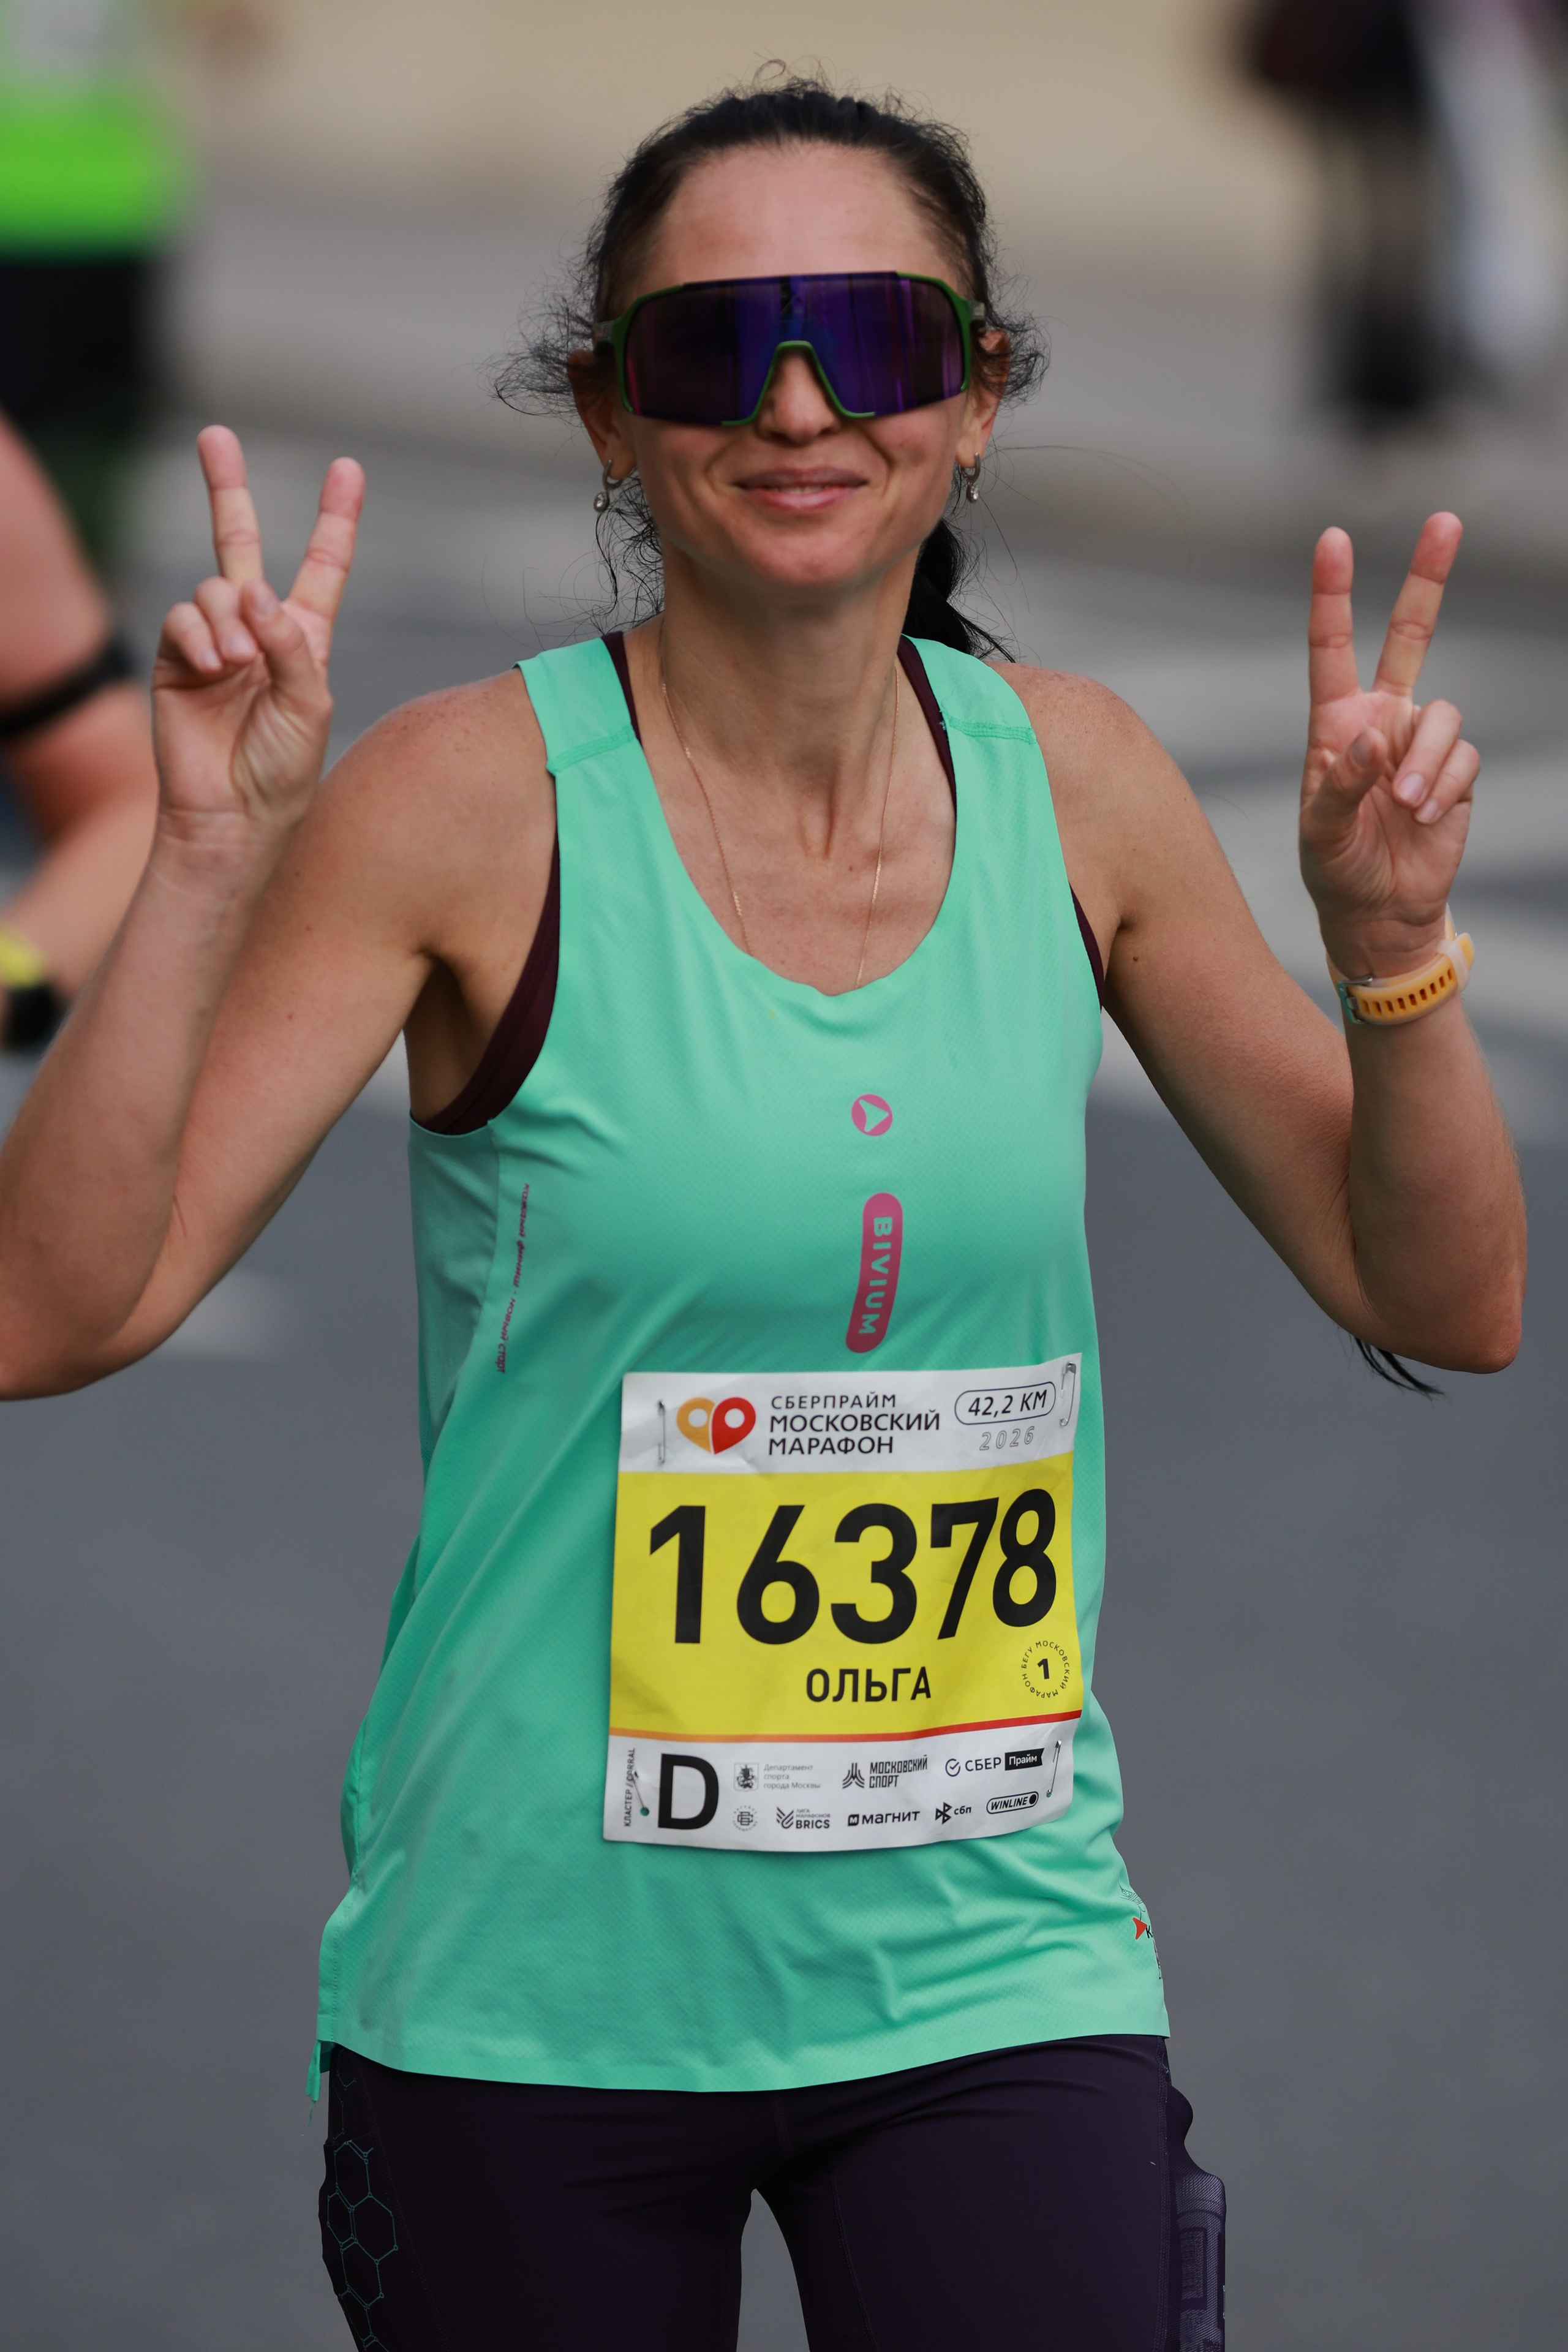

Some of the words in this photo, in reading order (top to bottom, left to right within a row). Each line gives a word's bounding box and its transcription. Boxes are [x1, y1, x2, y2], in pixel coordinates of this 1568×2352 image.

[859, 1216, 892, 1334] BIVIUM
[771, 1391, 895, 1409] СБЕРПРАЙМ
[968, 1395, 1014, 1418] 42,2
[1020, 1389, 1047, 1412] КМ
[770, 1409, 940, 1433] МОСКОВСКИЙ
[769, 1436, 893, 1455] МАРАФОН
[979, 1426, 1035, 1450] 2026
[650, 1488, 1057, 1645] 16378
[1021, 1646, 1033, 1669] БЕГУ
[1035, 1640, 1070, 1689] МОСКОВСКИЙ
[1037, 1658, 1050, 1679] 1
[806, 1667, 931, 1703] ОЛЬГА
[1022, 1673, 1058, 1698] МАРАФОН
[870, 1754, 928, 1774] МОСКОВСКИЙ
[965, 1757, 1001, 1771] СБЕР
[1009, 1754, 1038, 1766] Прайм
[657, 1753, 719, 1830] D
[869, 1775, 899, 1788] СПОРТ
[624, 1789, 633, 1827] КЛАСТЕР
[954, 1806, 971, 1815] сбп
[990, 1796, 1028, 1811] WINLINE
[796, 1820, 830, 1829] BRICS
